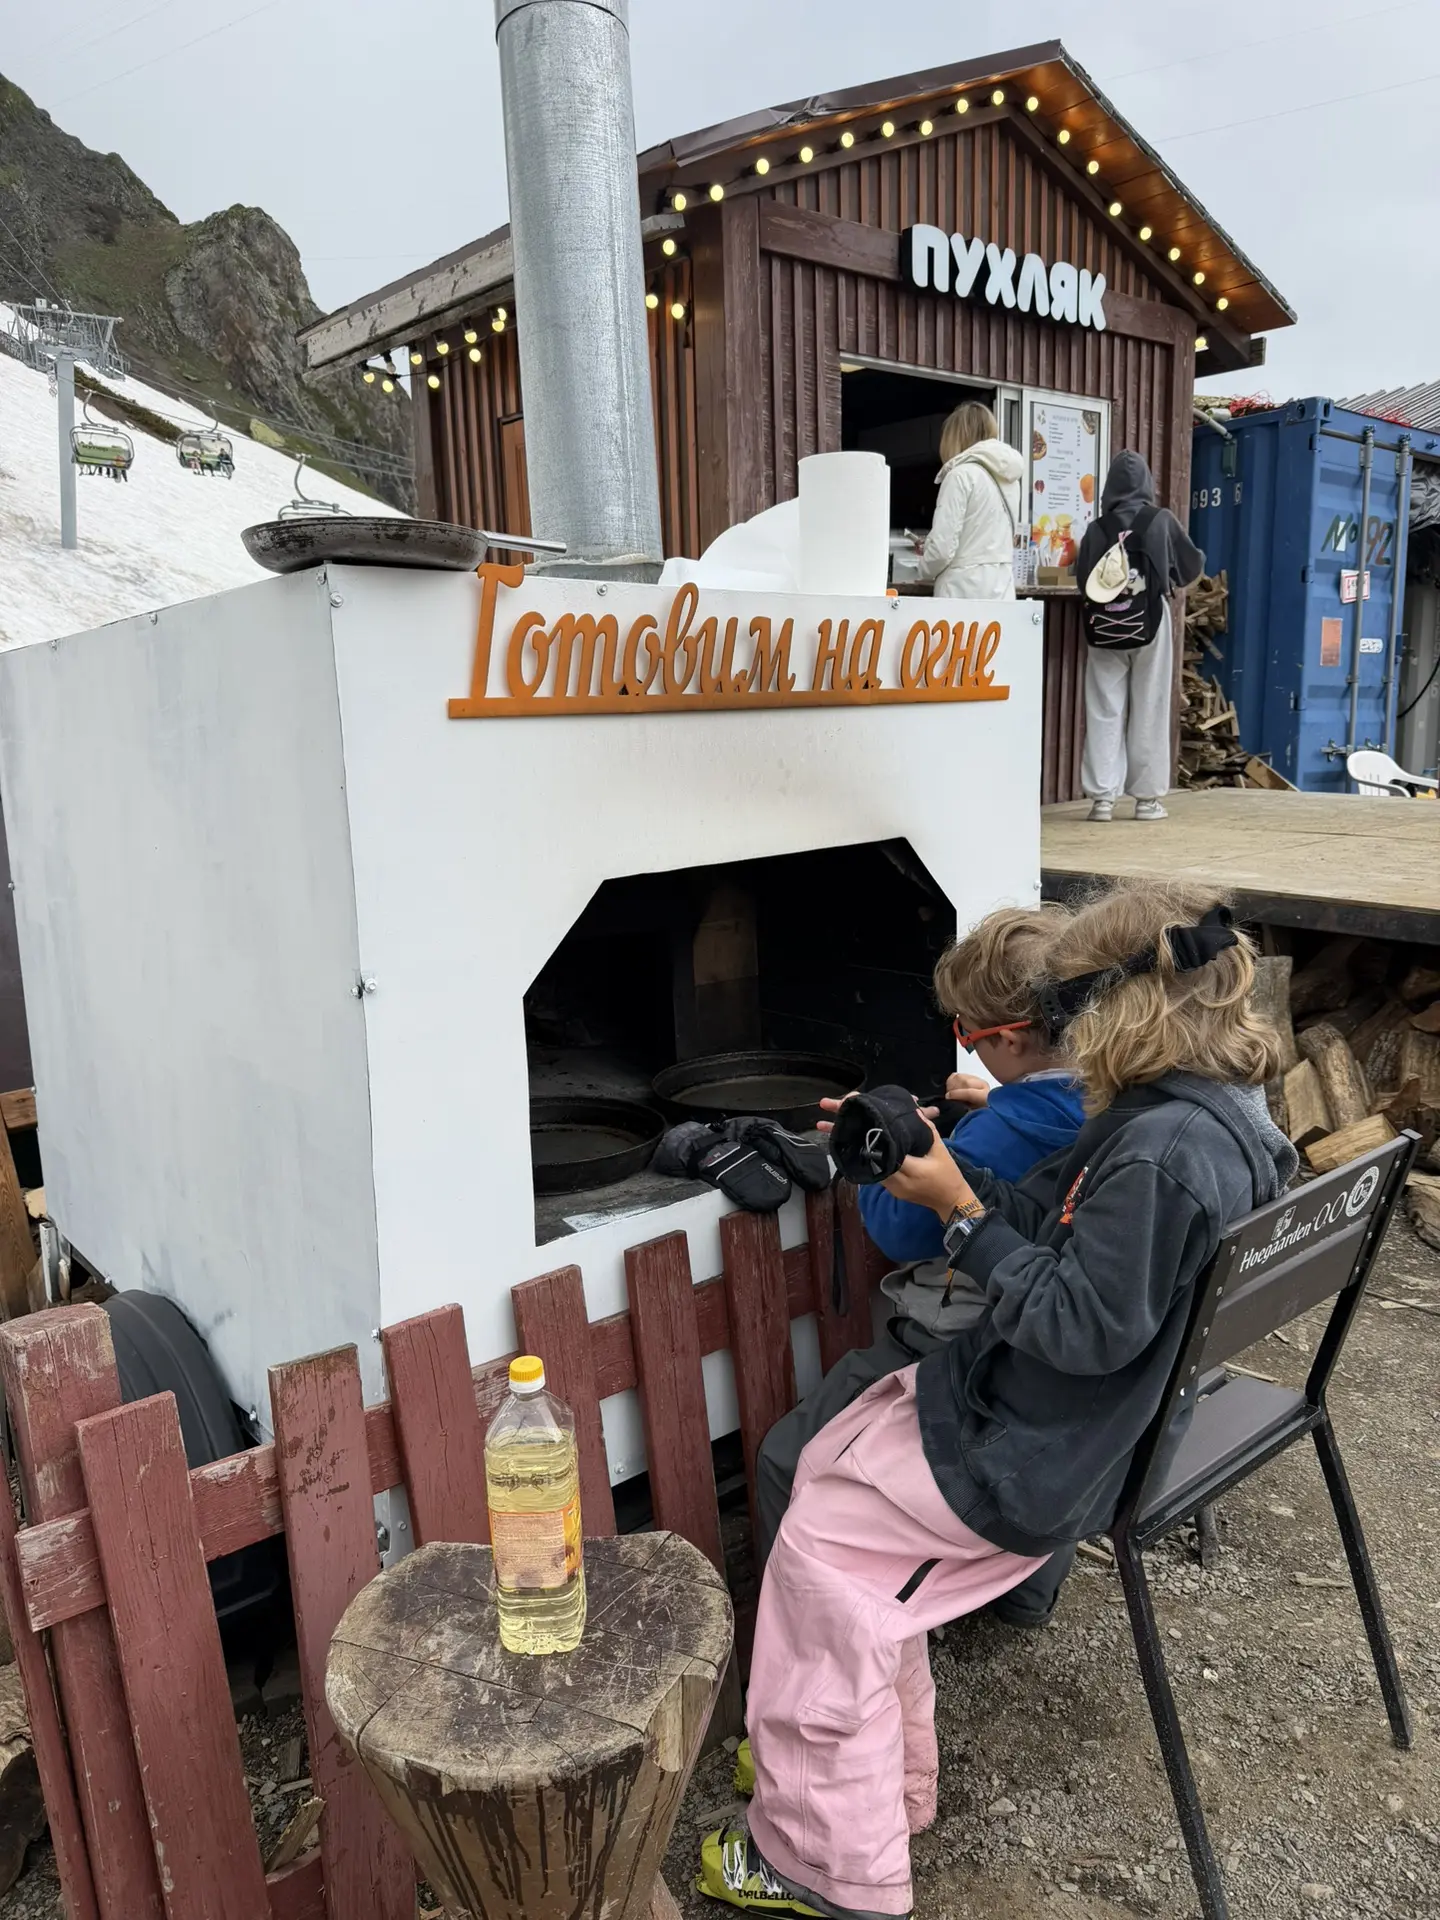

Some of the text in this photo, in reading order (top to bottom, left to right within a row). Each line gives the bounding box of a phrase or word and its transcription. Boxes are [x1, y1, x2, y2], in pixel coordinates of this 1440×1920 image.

[912, 223, 1107, 331] ПУХЛЯК
[470, 562, 1001, 699] Готовим на огне
[762, 1163, 788, 1184] reusch
[1239, 1221, 1312, 1274] Hoegaarden
